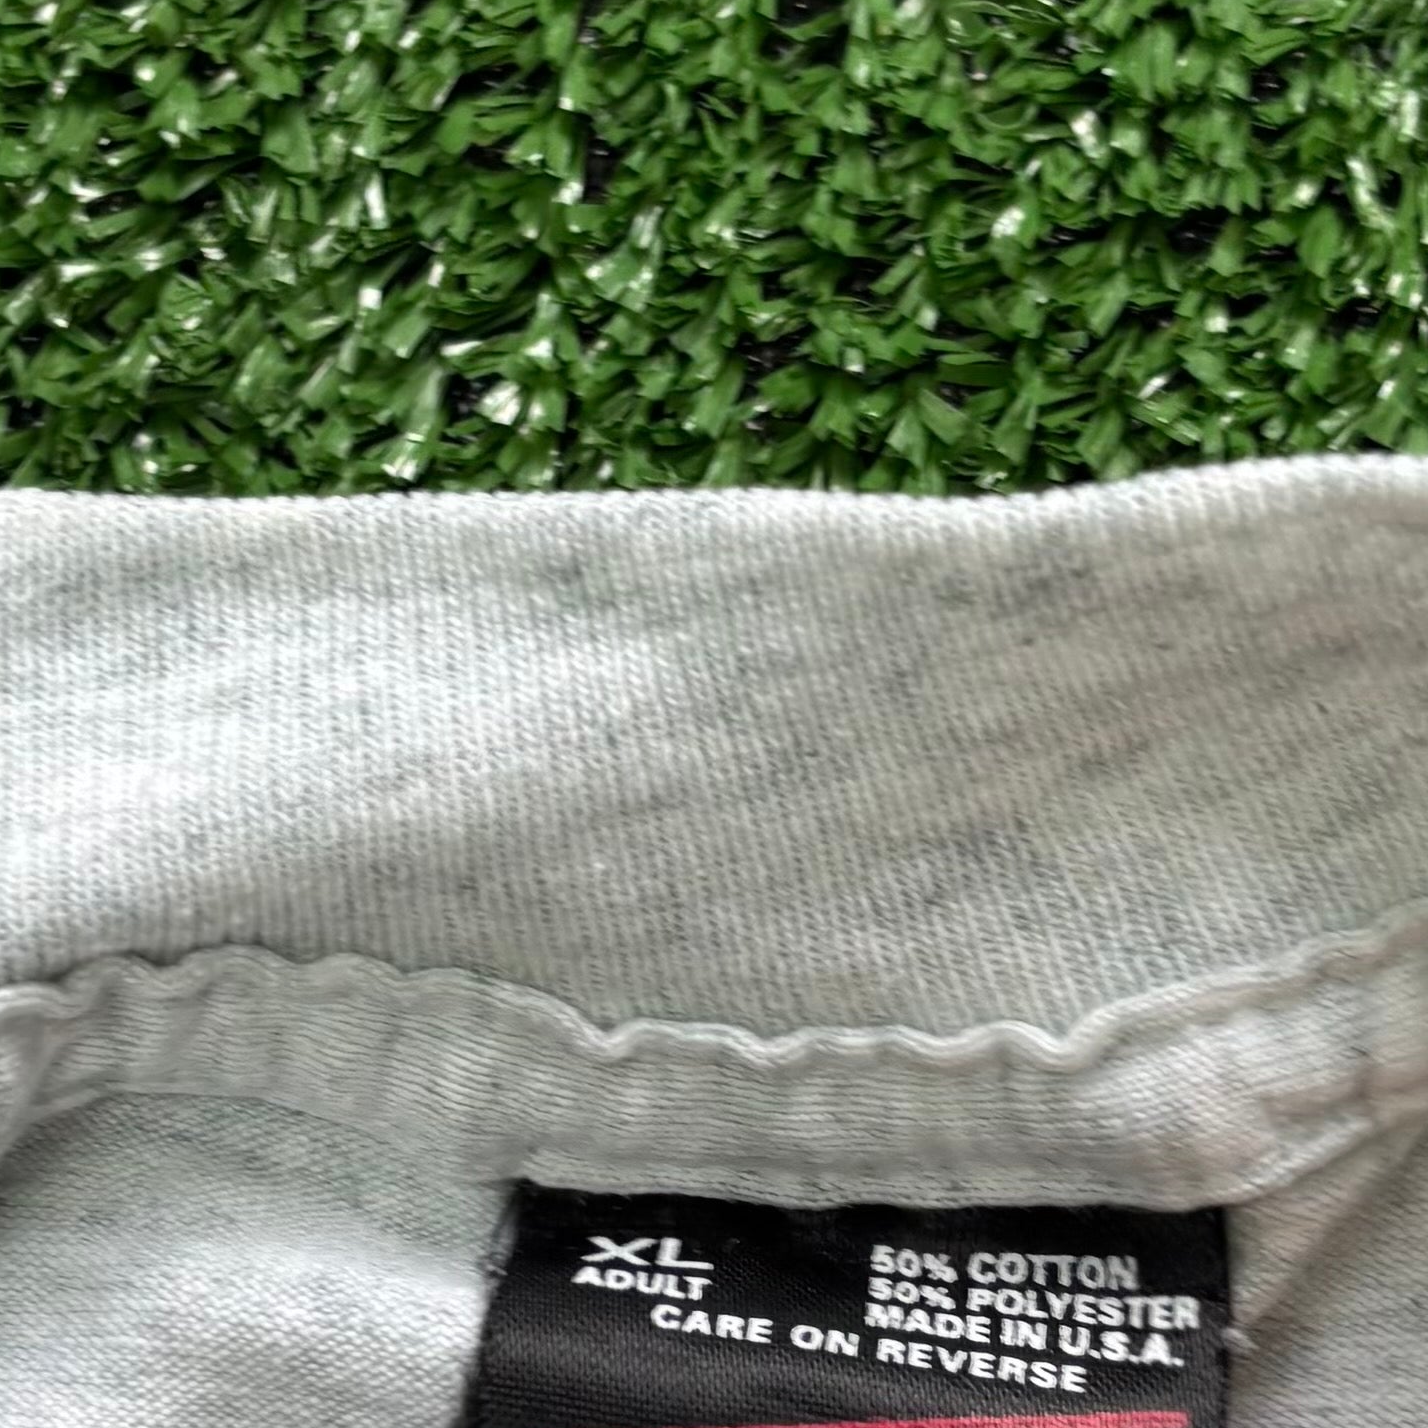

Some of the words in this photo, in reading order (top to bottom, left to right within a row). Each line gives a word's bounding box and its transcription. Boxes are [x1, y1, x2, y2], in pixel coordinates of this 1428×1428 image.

[580, 1235, 715, 1270] XL
[870, 1244, 959, 1283] 50%
[967, 1251, 1140, 1292] COTTON
[571, 1265, 713, 1301] ADULT
[868, 1276, 957, 1311] 50%
[966, 1287, 1200, 1331] POLYESTER
[650, 1303, 775, 1344] CARE
[789, 1323, 860, 1359] ON
[876, 1338, 1089, 1394] REVERSE
[863, 1301, 992, 1344] MADE
[999, 1318, 1048, 1351] IN
[1058, 1324, 1185, 1367] U.S.A.
